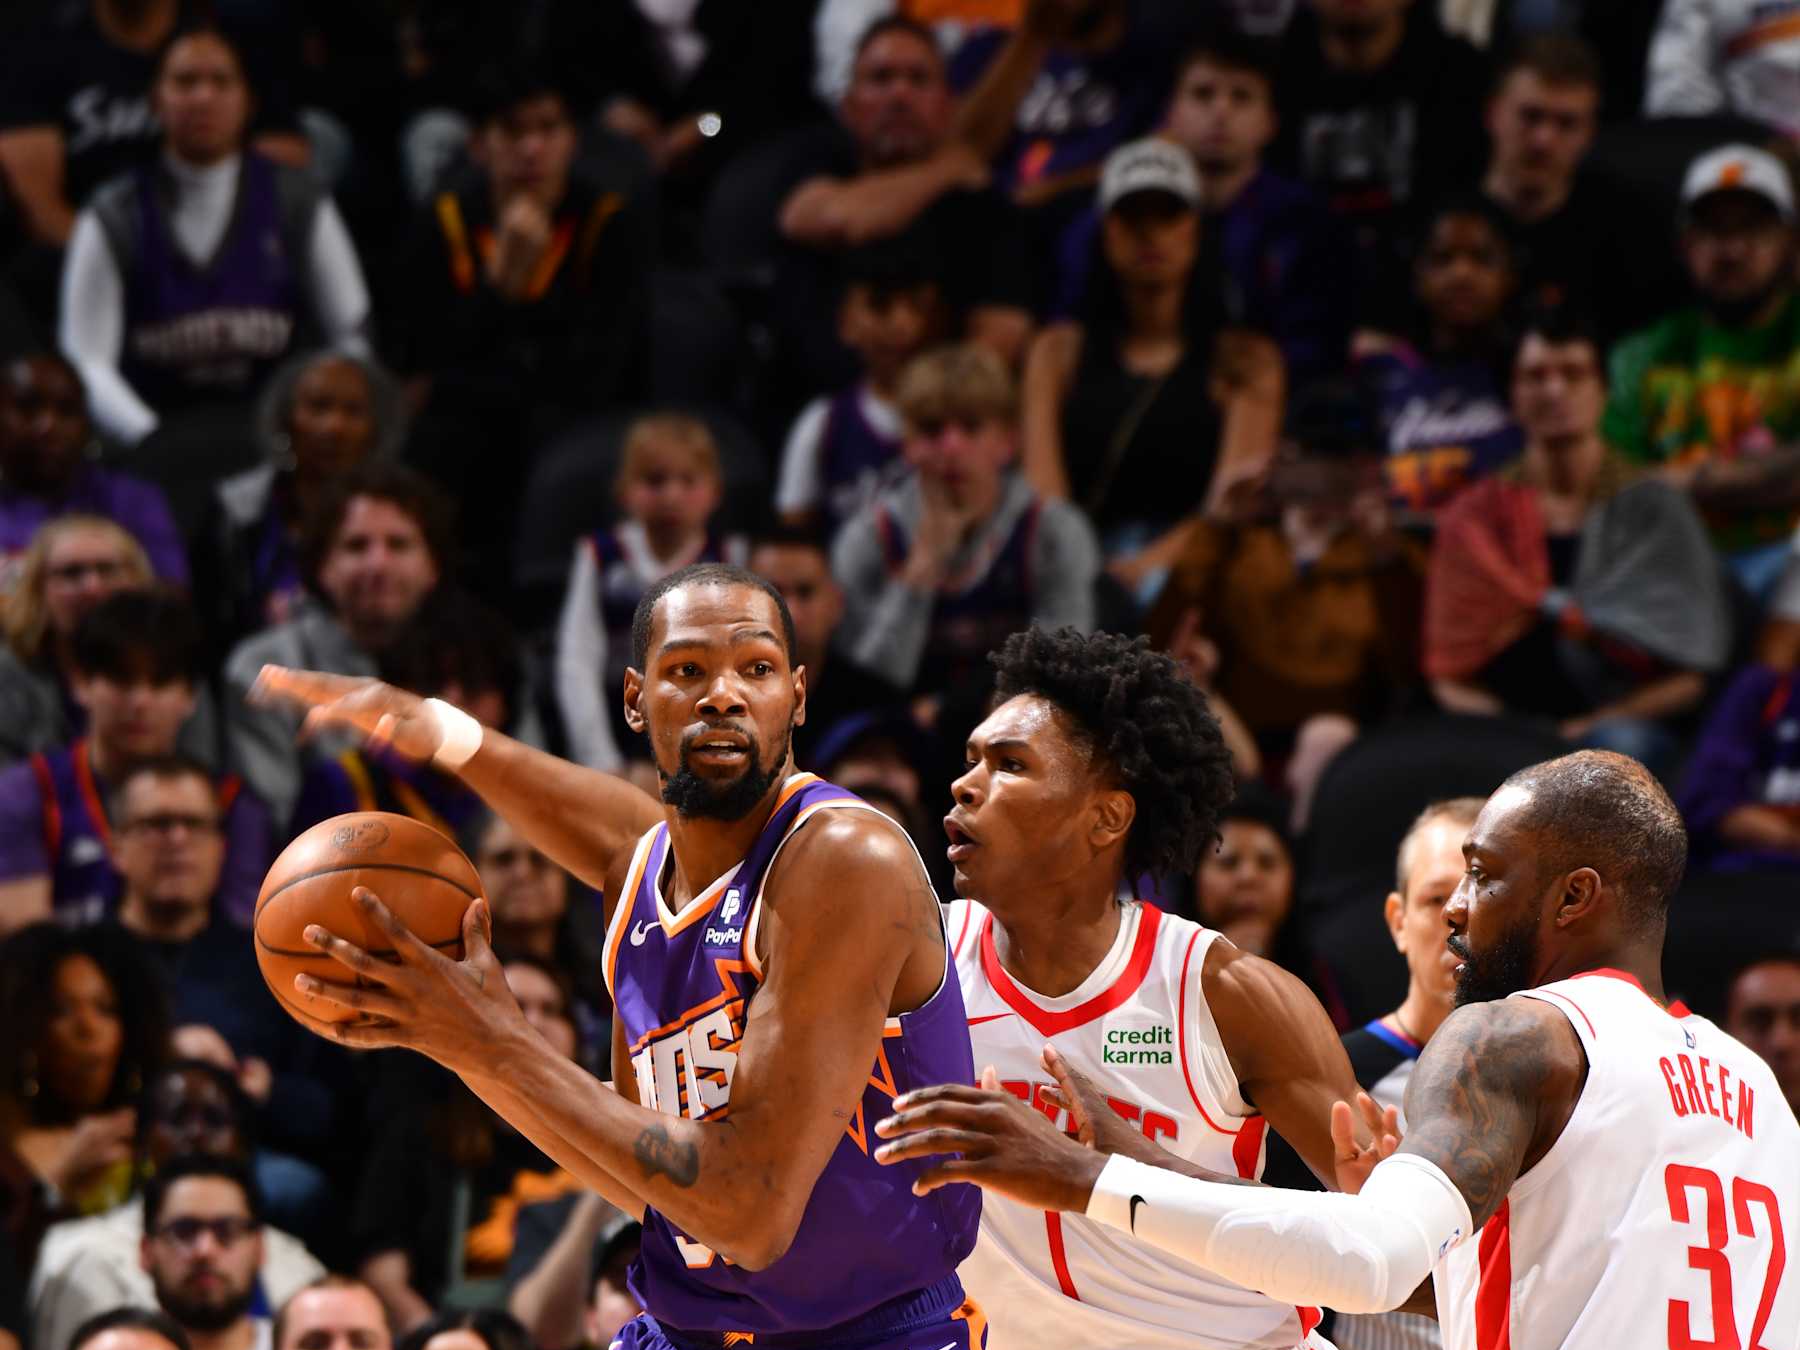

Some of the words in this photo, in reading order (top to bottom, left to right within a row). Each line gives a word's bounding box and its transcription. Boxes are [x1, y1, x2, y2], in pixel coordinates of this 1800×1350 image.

[1107, 1025, 1173, 1045] credit
[1103, 1045, 1173, 1065] karma
[1659, 1053, 1754, 1140] GREEN
